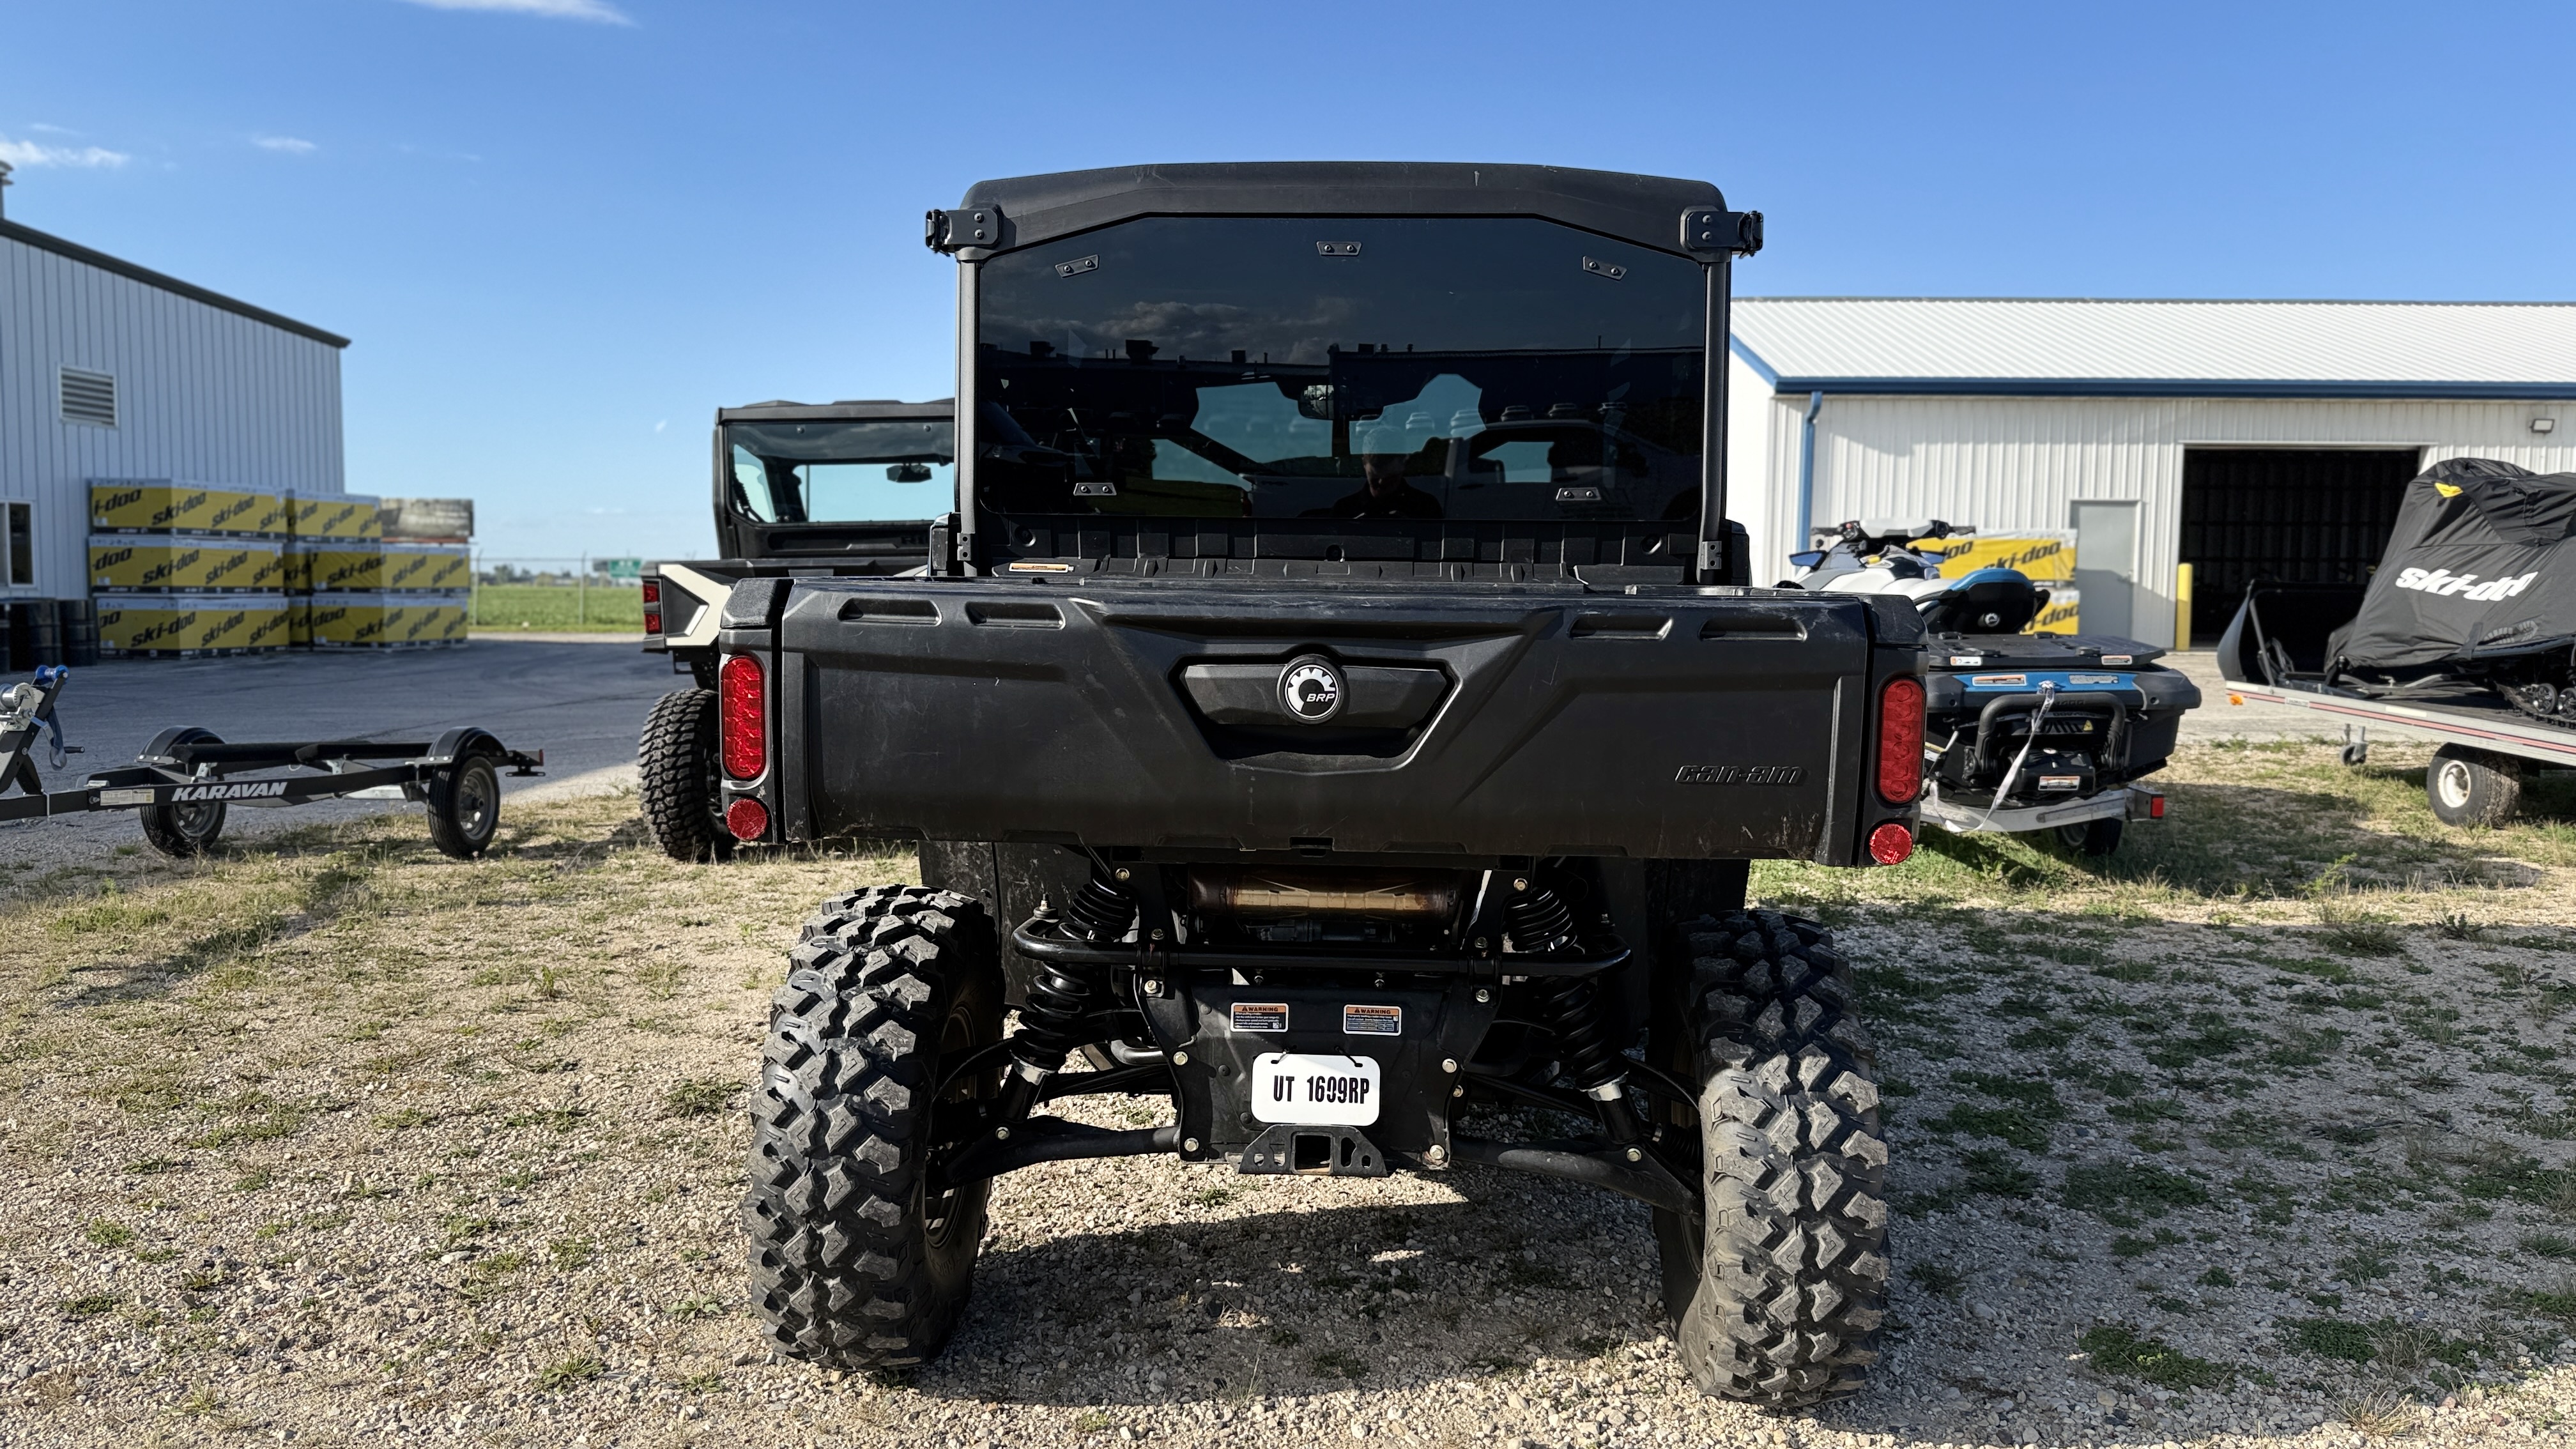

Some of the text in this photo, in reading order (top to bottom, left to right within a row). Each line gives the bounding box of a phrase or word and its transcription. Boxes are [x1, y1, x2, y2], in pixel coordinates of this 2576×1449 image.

[151, 492, 206, 526] ski-doo
[211, 496, 254, 528] ski-doo
[142, 549, 199, 585] ski-doo
[206, 551, 247, 585] ski-doo
[131, 611, 196, 647] ski-doo
[201, 611, 245, 647] ski-doo
[1306, 693, 1335, 702] BRP
[1675, 765, 1804, 784] can-am
[171, 782, 288, 802] KARAVAN
[1273, 1075, 1370, 1104] UT 1609RP
